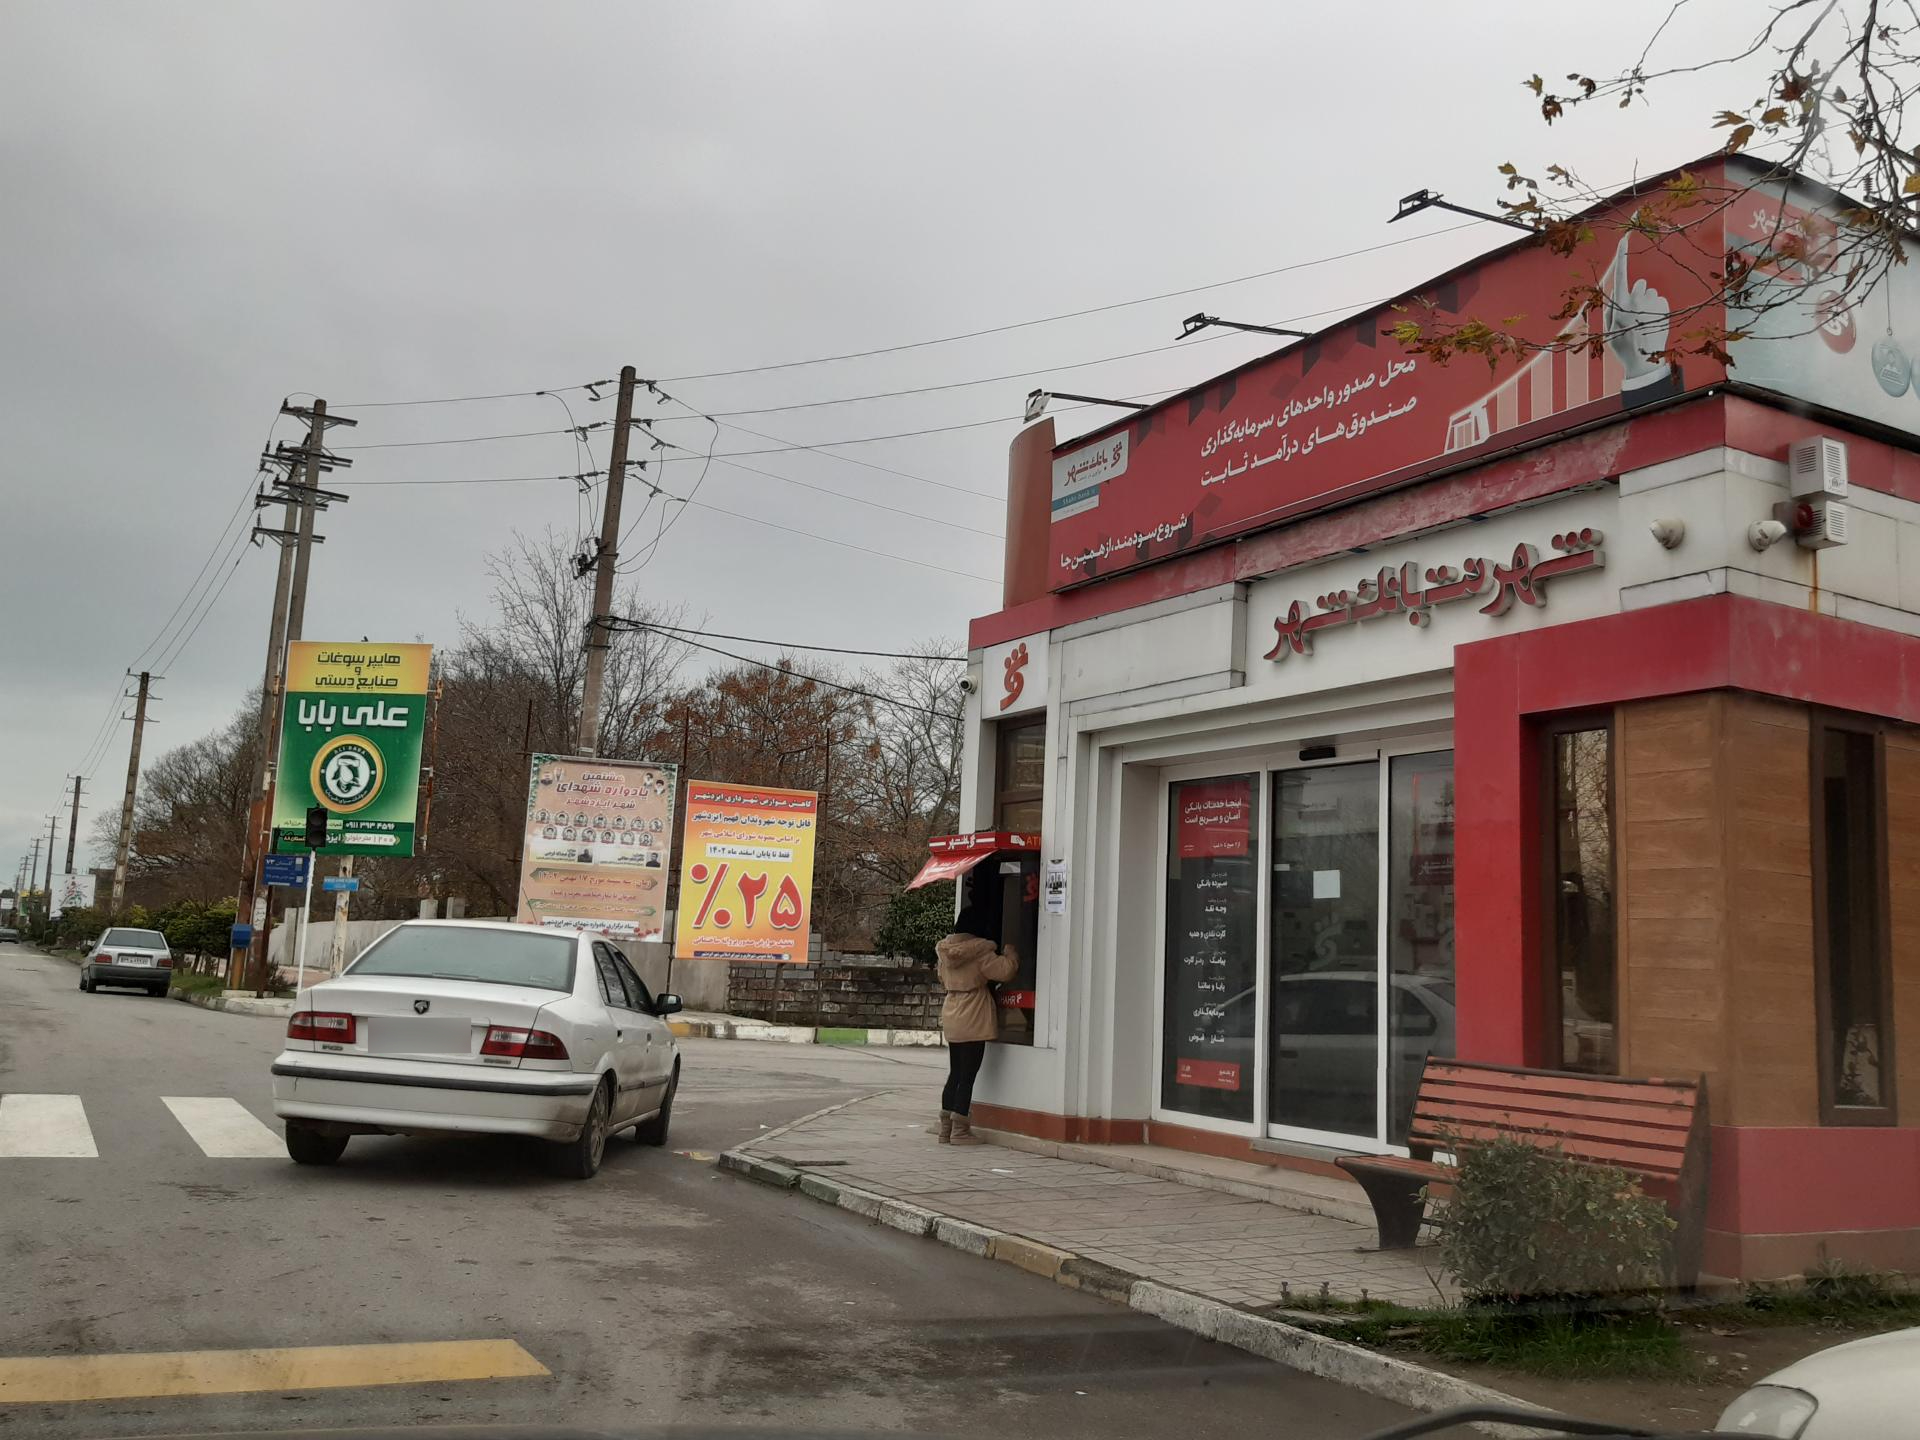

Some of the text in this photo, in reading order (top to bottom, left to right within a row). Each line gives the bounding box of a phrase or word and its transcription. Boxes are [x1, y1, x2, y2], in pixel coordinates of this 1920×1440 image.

[1379, 358, 1416, 388] محل
[1335, 372, 1376, 405] صدور
[1276, 385, 1335, 428] واحدهای
[1088, 448, 1108, 471] بانک
[1250, 434, 1299, 469] درآمد
[1063, 460, 1090, 487] شهر
[1200, 449, 1249, 486] ثابت
[1156, 512, 1188, 542] شروع
[1262, 588, 1358, 663] شهر
[317, 651, 401, 669] هایپر سوغات
[354, 665, 362, 676] و
[315, 674, 399, 690] صنایع دستی
[298, 698, 409, 732] علی بابا
[556, 780, 649, 799] یادواره شهدای
[566, 796, 636, 809] شهر ایزدشهر
[694, 791, 813, 808] کاهش عوارض شهرداری ایزدشهر
[1184, 801, 1202, 814] بانکی
[346, 821, 359, 829] ۰۹۱۱
[692, 811, 811, 829] قابل توجه شهروندان فهیم ایزدشهر
[1184, 814, 1198, 824] است
[1198, 815, 1219, 825] سریع
[714, 831, 736, 840] اسلامی
[736, 833, 757, 841] شورای
[738, 849, 756, 857] اسفند
[756, 849, 772, 859] پایان
[1196, 879, 1212, 889] بانکی
[1204, 904, 1227, 914] وجه نقد
